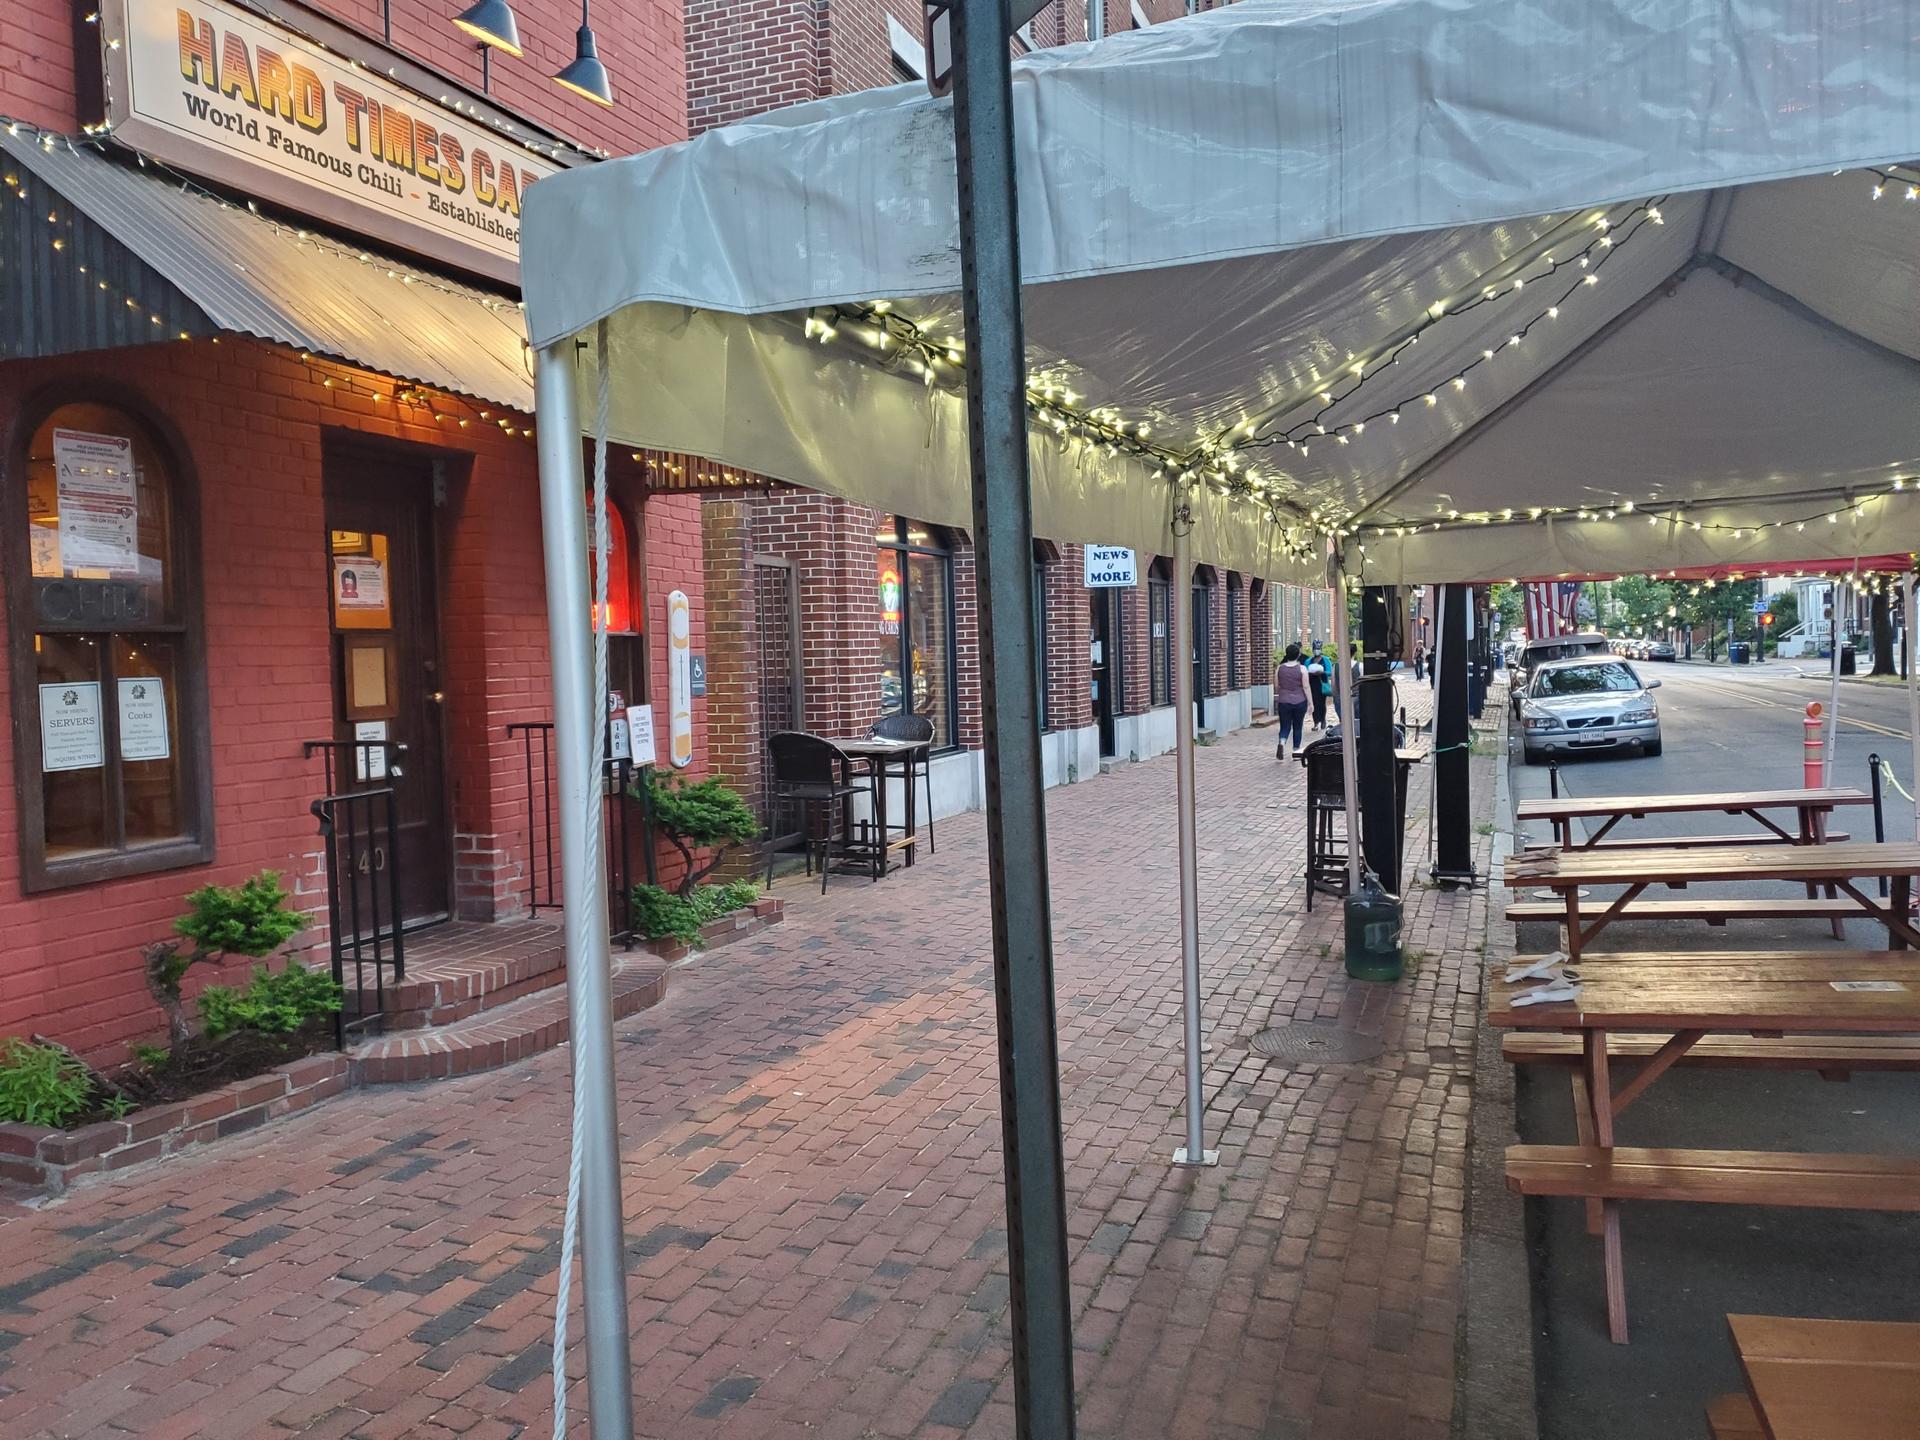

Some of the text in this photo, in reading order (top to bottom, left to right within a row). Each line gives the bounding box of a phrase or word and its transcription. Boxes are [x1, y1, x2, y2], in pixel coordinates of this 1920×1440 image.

[177, 8, 327, 135] HARD
[333, 80, 466, 195] TIMES
[182, 91, 261, 142] World
[265, 125, 353, 178] Famous
[357, 163, 404, 198] Chili
[1093, 550, 1129, 561] NEWS
[1106, 562, 1115, 570] &
[1090, 571, 1131, 583] MORE
[127, 711, 153, 720] Cooks
[49, 716, 95, 728] SERVERS
